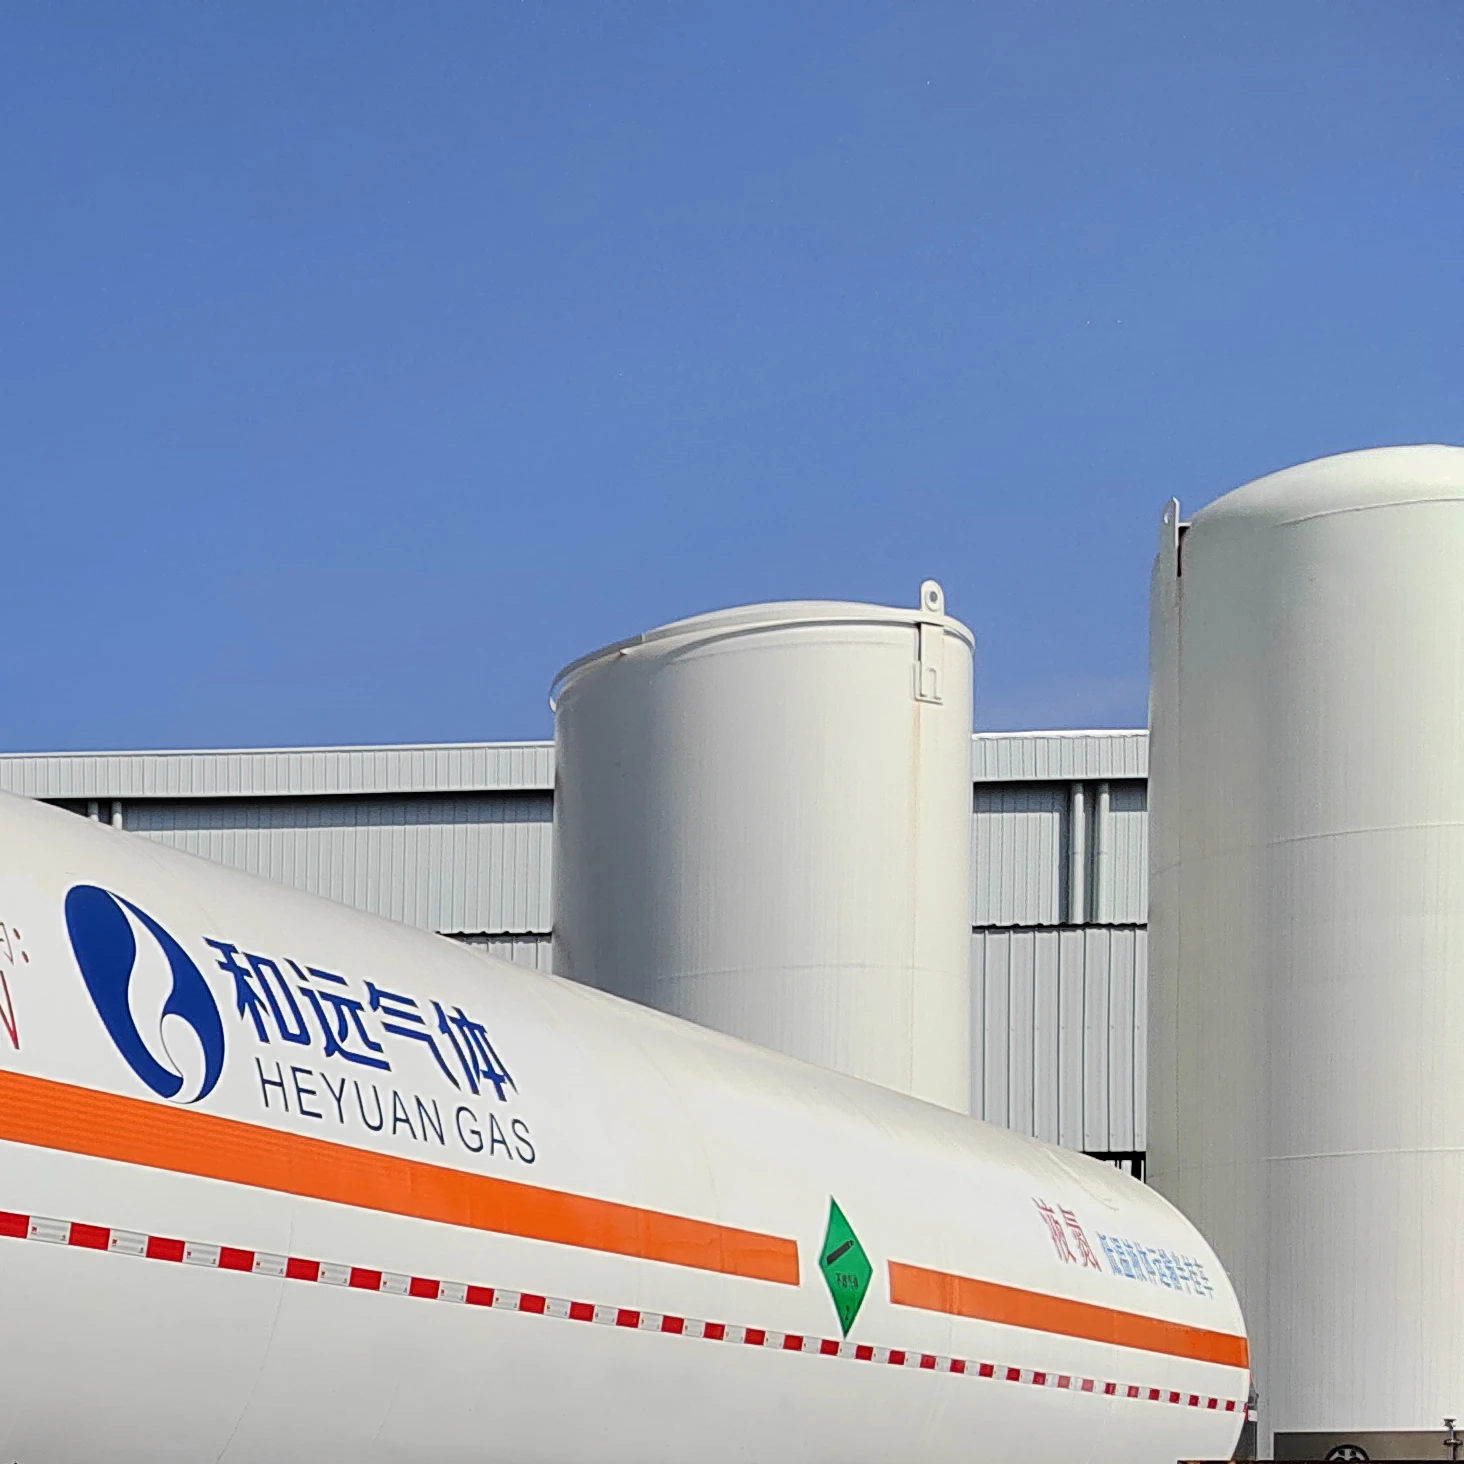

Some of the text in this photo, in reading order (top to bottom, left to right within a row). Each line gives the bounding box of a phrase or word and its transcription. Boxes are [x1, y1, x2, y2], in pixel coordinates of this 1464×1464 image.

[202, 936, 519, 1101] 和远气体
[255, 1057, 535, 1164] HEYUAN GAS
[1031, 1197, 1102, 1272] 液氮
